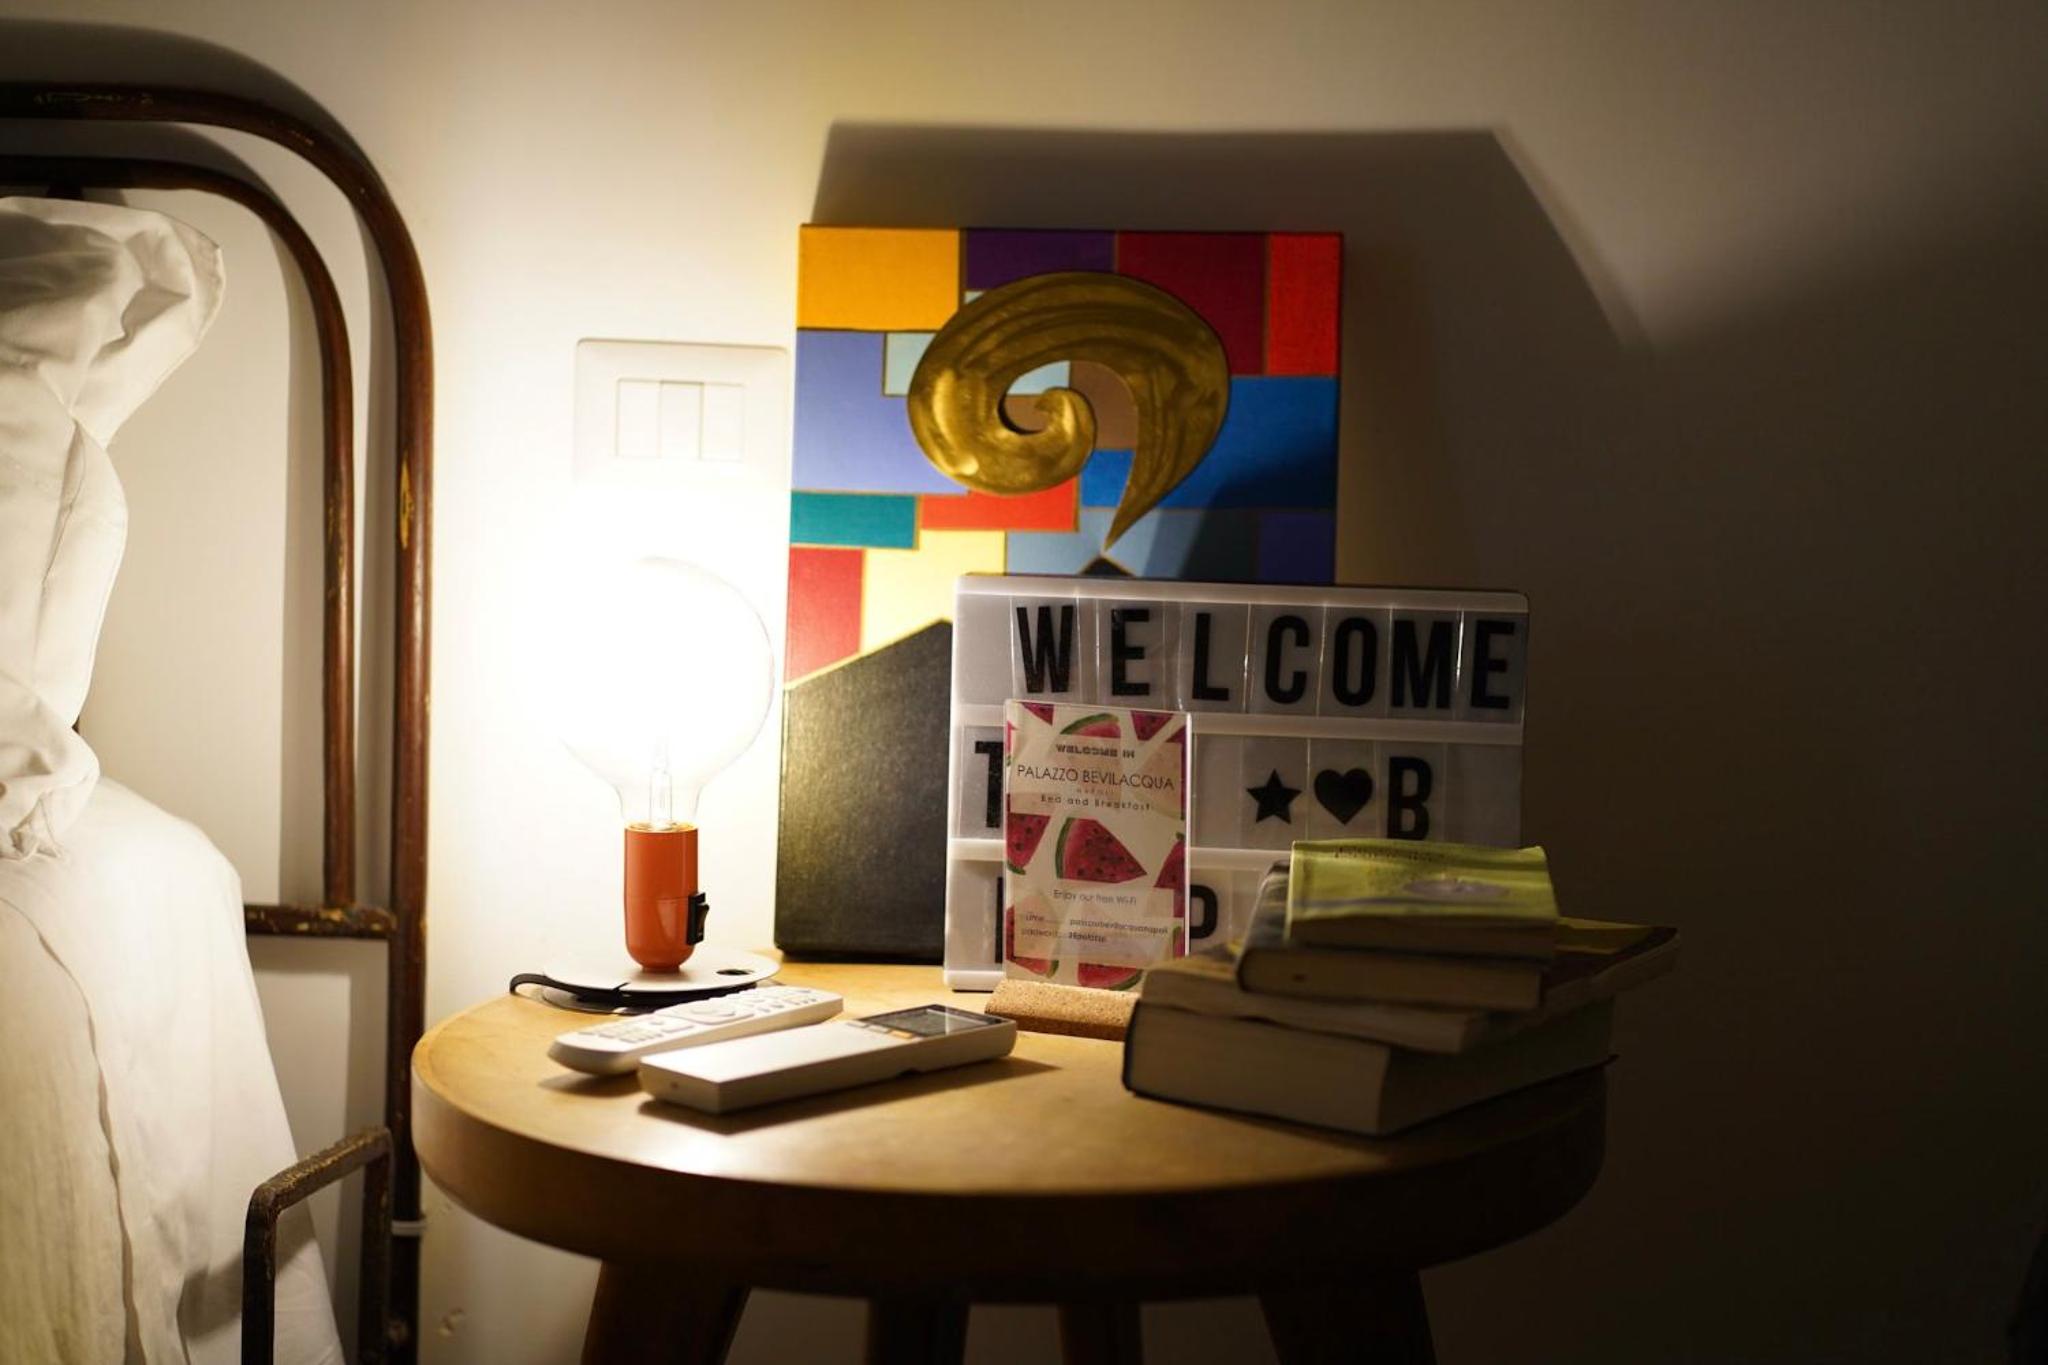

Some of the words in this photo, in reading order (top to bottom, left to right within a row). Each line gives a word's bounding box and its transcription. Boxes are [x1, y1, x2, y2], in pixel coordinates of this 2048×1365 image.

[1016, 604, 1518, 711] WELCOME
[1056, 743, 1118, 758] WELCOME
[1017, 764, 1079, 782] PALAZZO
[1082, 770, 1175, 791] BEVILACQUA
[1067, 796, 1089, 806] and
[1053, 889, 1077, 902] Enjoy
